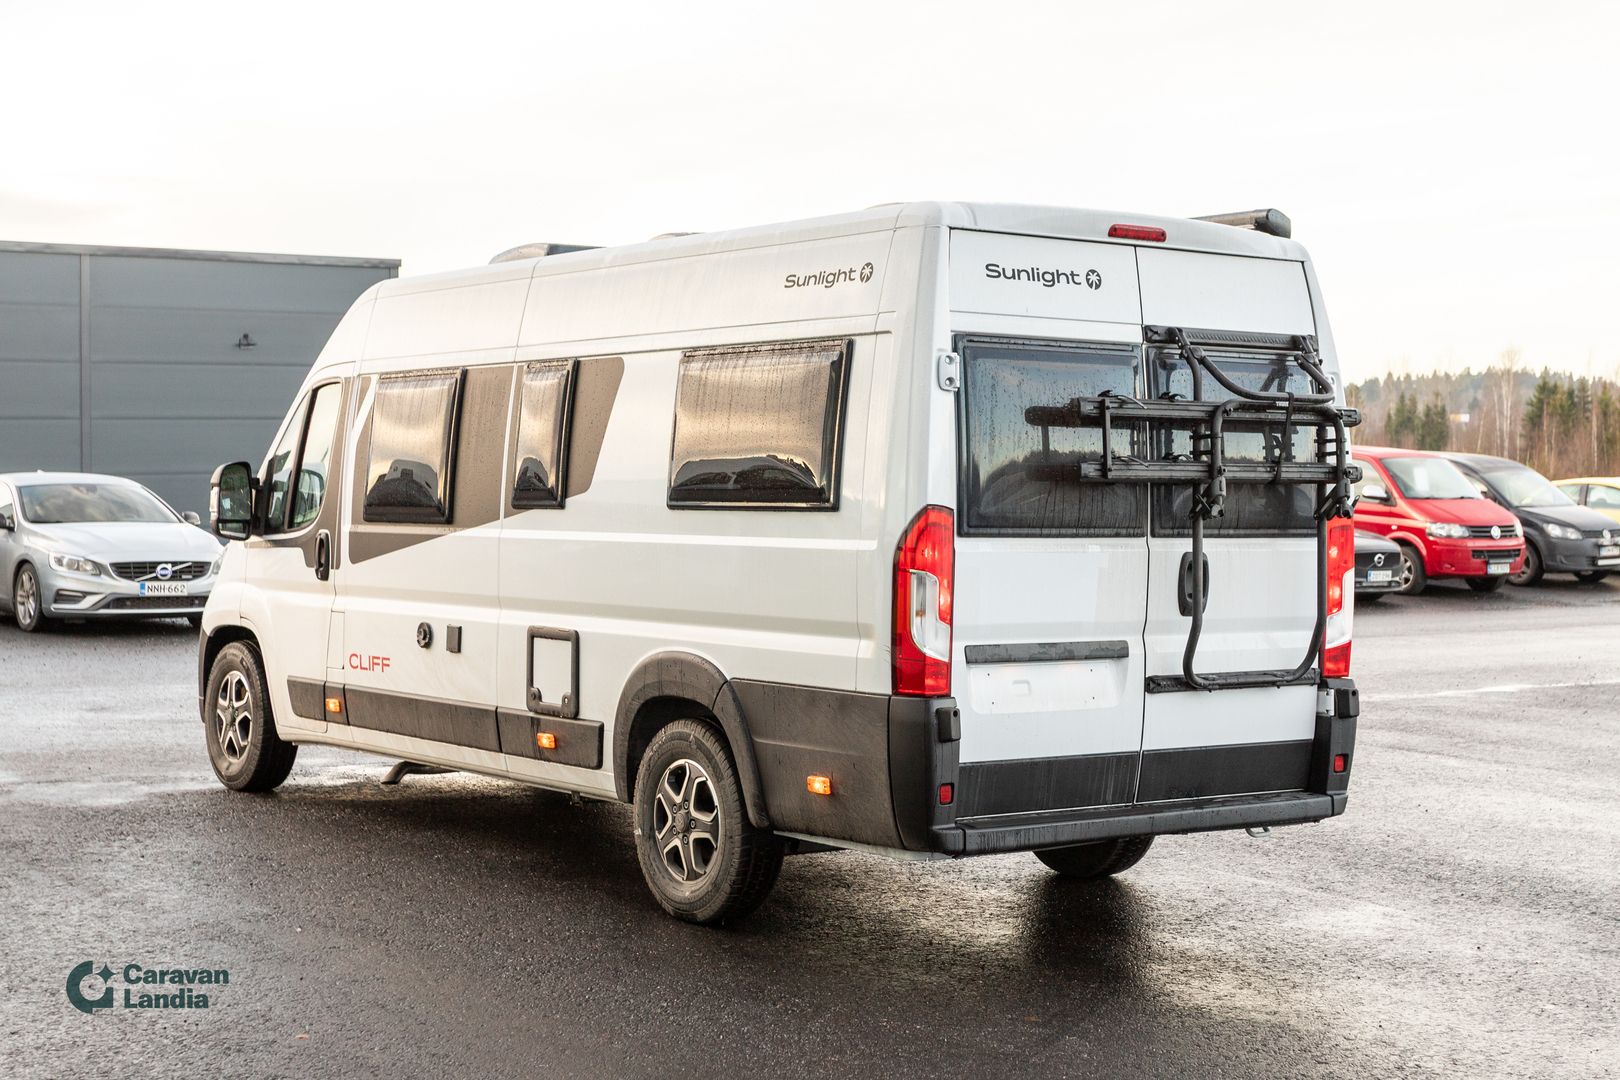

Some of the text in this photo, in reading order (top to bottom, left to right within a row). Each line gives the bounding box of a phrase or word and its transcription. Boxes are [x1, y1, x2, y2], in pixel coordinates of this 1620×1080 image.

[784, 267, 856, 289] Sunlight
[985, 263, 1082, 288] Sunlight
[147, 584, 186, 594] NNH-662
[349, 653, 391, 672] CLIFF
